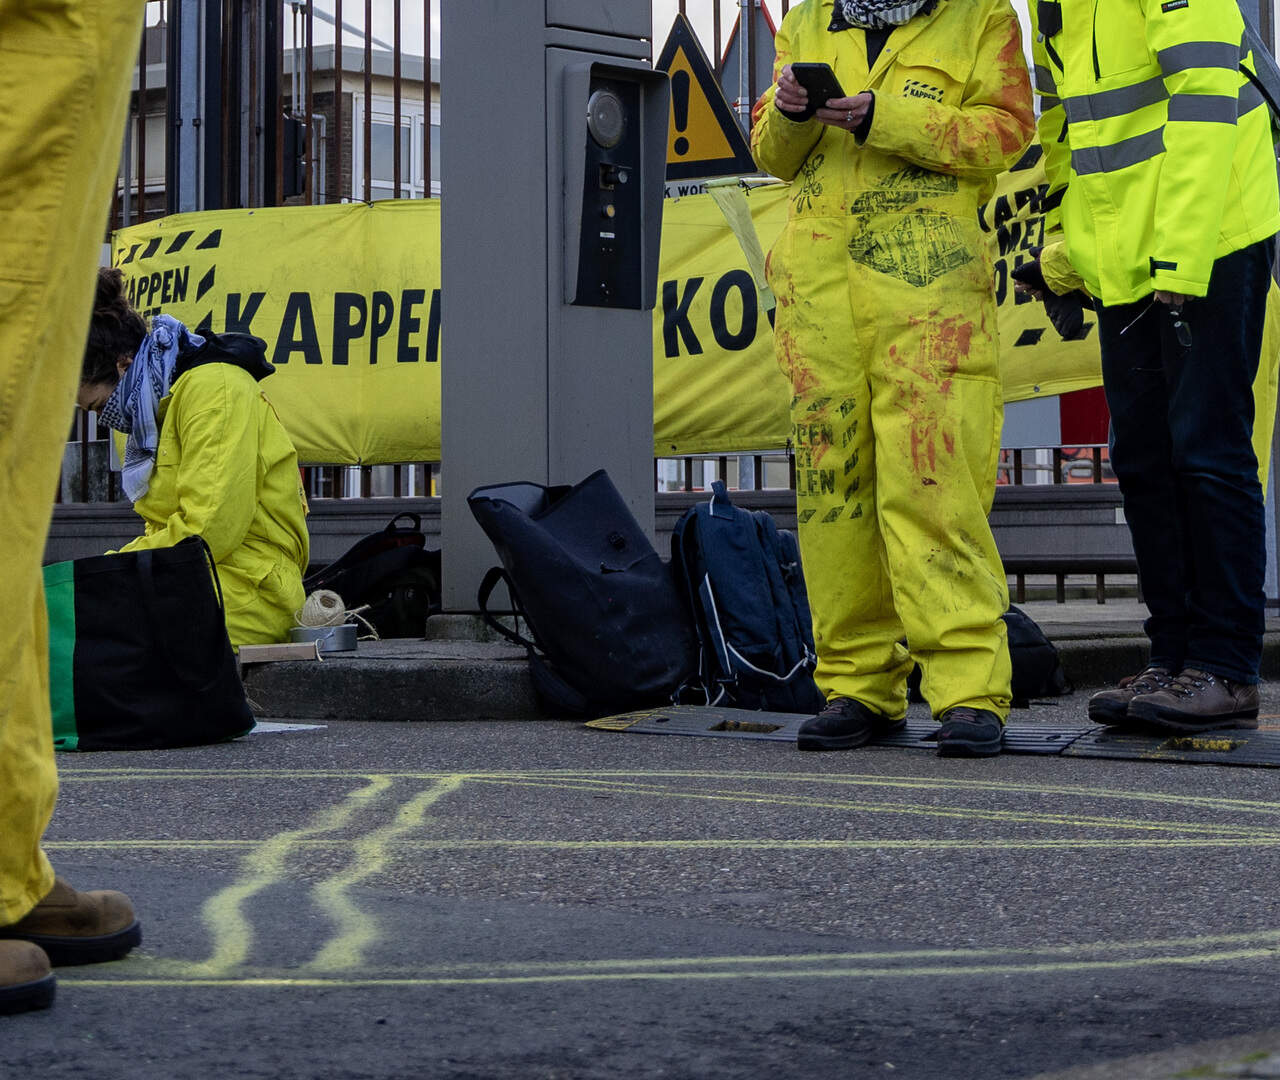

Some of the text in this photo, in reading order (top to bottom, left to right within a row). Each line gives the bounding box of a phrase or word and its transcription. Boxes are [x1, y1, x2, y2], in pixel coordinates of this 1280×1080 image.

[910, 88, 937, 101] KAPPEN
[122, 265, 190, 310] APPEN
[663, 269, 777, 358] KO
